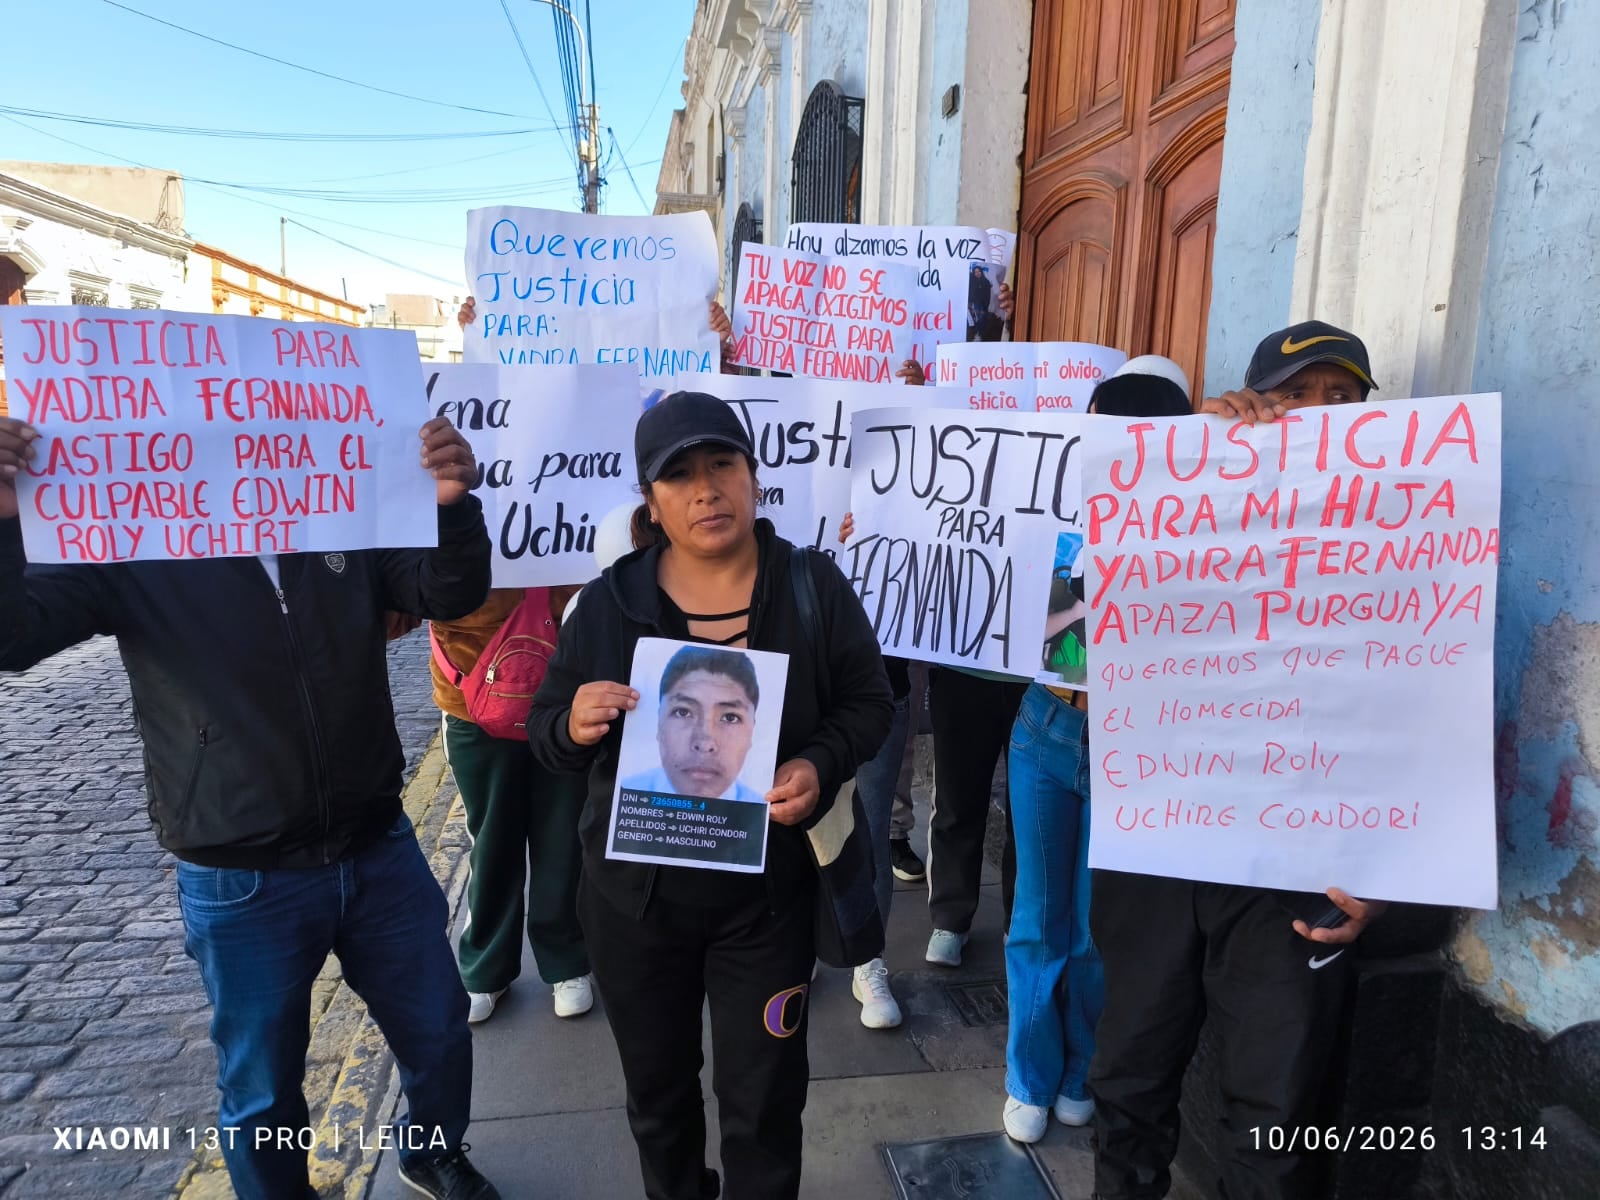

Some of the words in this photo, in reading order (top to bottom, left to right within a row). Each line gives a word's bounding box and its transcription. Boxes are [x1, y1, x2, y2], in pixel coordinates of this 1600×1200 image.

[490, 219, 676, 261] Queremos
[835, 228, 908, 257] alzamos
[917, 230, 936, 259] la
[477, 267, 635, 306] Justicia
[745, 253, 770, 280] TU
[783, 258, 817, 287] VOZ
[822, 264, 846, 290] NO
[860, 268, 887, 296] SE
[744, 281, 811, 315] APAGA,
[814, 292, 908, 326] EXIGIMOS
[21, 319, 227, 367] JUSTICIA
[272, 328, 360, 367] PARA
[484, 313, 558, 338] PARA:
[744, 310, 837, 349] JUSTICIA
[848, 325, 894, 353] PARA
[803, 348, 891, 383] FERNANDA
[940, 358, 957, 382] Ni
[1034, 361, 1048, 379] ni
[1059, 358, 1102, 380] olvido
[15, 376, 167, 424] YADIRA
[195, 378, 384, 427] FERNANDA,
[969, 391, 1018, 410] sticia
[1036, 395, 1072, 412] para
[235, 434, 316, 470] PARA
[339, 434, 372, 470] EL
[721, 400, 852, 469] Justi
[1109, 402, 1478, 492] JUSTICIA
[528, 451, 621, 494] para
[866, 425, 1082, 527] JUSTIC
[35, 481, 210, 521] CULPABLE
[232, 474, 354, 520] EDWIN
[1087, 493, 1217, 545] PARA
[1240, 487, 1299, 532] MI
[1319, 474, 1456, 530] HIJA
[57, 523, 144, 561] ROLY
[164, 519, 299, 558] UCHIRI
[938, 507, 1005, 547] PARA
[1091, 544, 1266, 609] YADIRA
[1276, 527, 1499, 589] FERNANDA
[847, 533, 1013, 669] FERNANDA
[1093, 601, 1236, 644] APAZA
[1254, 580, 1481, 641] PURGUAYA
[1364, 641, 1468, 670] PAGUE
[1103, 707, 1135, 733] EL
[1102, 750, 1235, 788] EDWIN
[621, 806, 664, 818] NOMBRES
[676, 812, 704, 822] EDWIN
[706, 814, 728, 824] ROLY
[622, 793, 638, 803] DNI
[617, 831, 653, 842] GENERO
[666, 836, 716, 849] MASCULINO
[618, 818, 666, 831] APELLIDOS
[679, 825, 707, 835] UCHIRI
[709, 827, 747, 839] CONDORI
